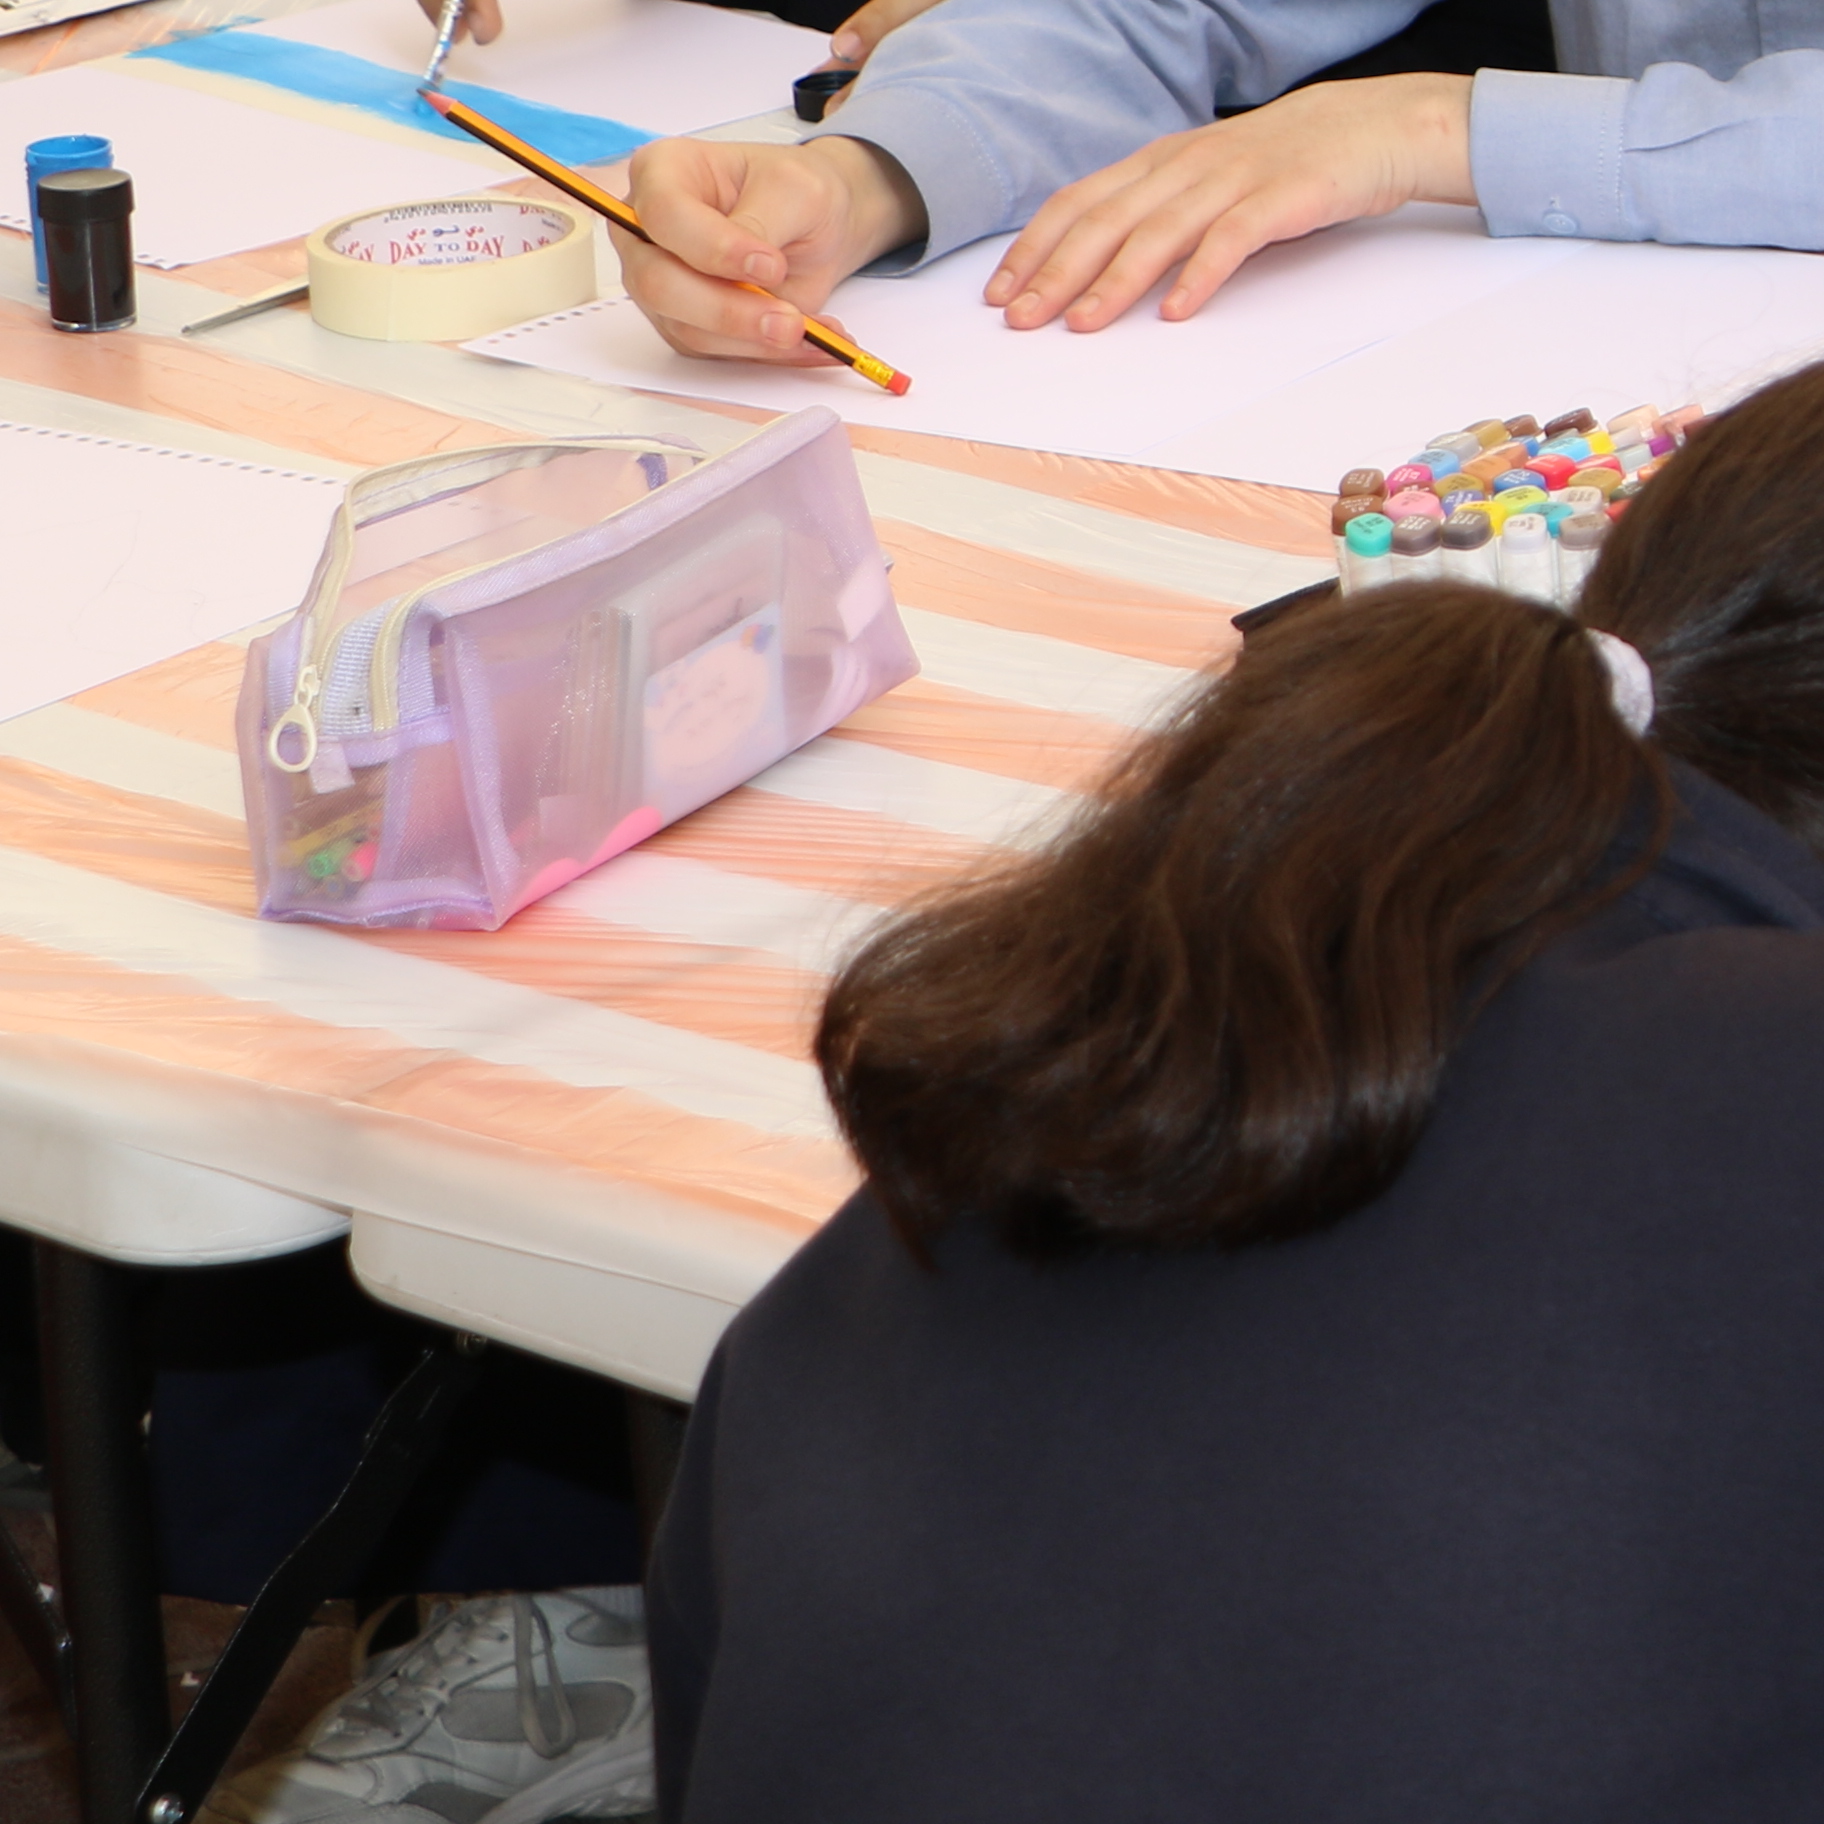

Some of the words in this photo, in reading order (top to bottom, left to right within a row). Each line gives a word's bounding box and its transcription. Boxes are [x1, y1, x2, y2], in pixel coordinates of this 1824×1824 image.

[389, 240, 426, 265] DAY
[434, 242, 460, 252] TO
[466, 236, 504, 258] DAY
